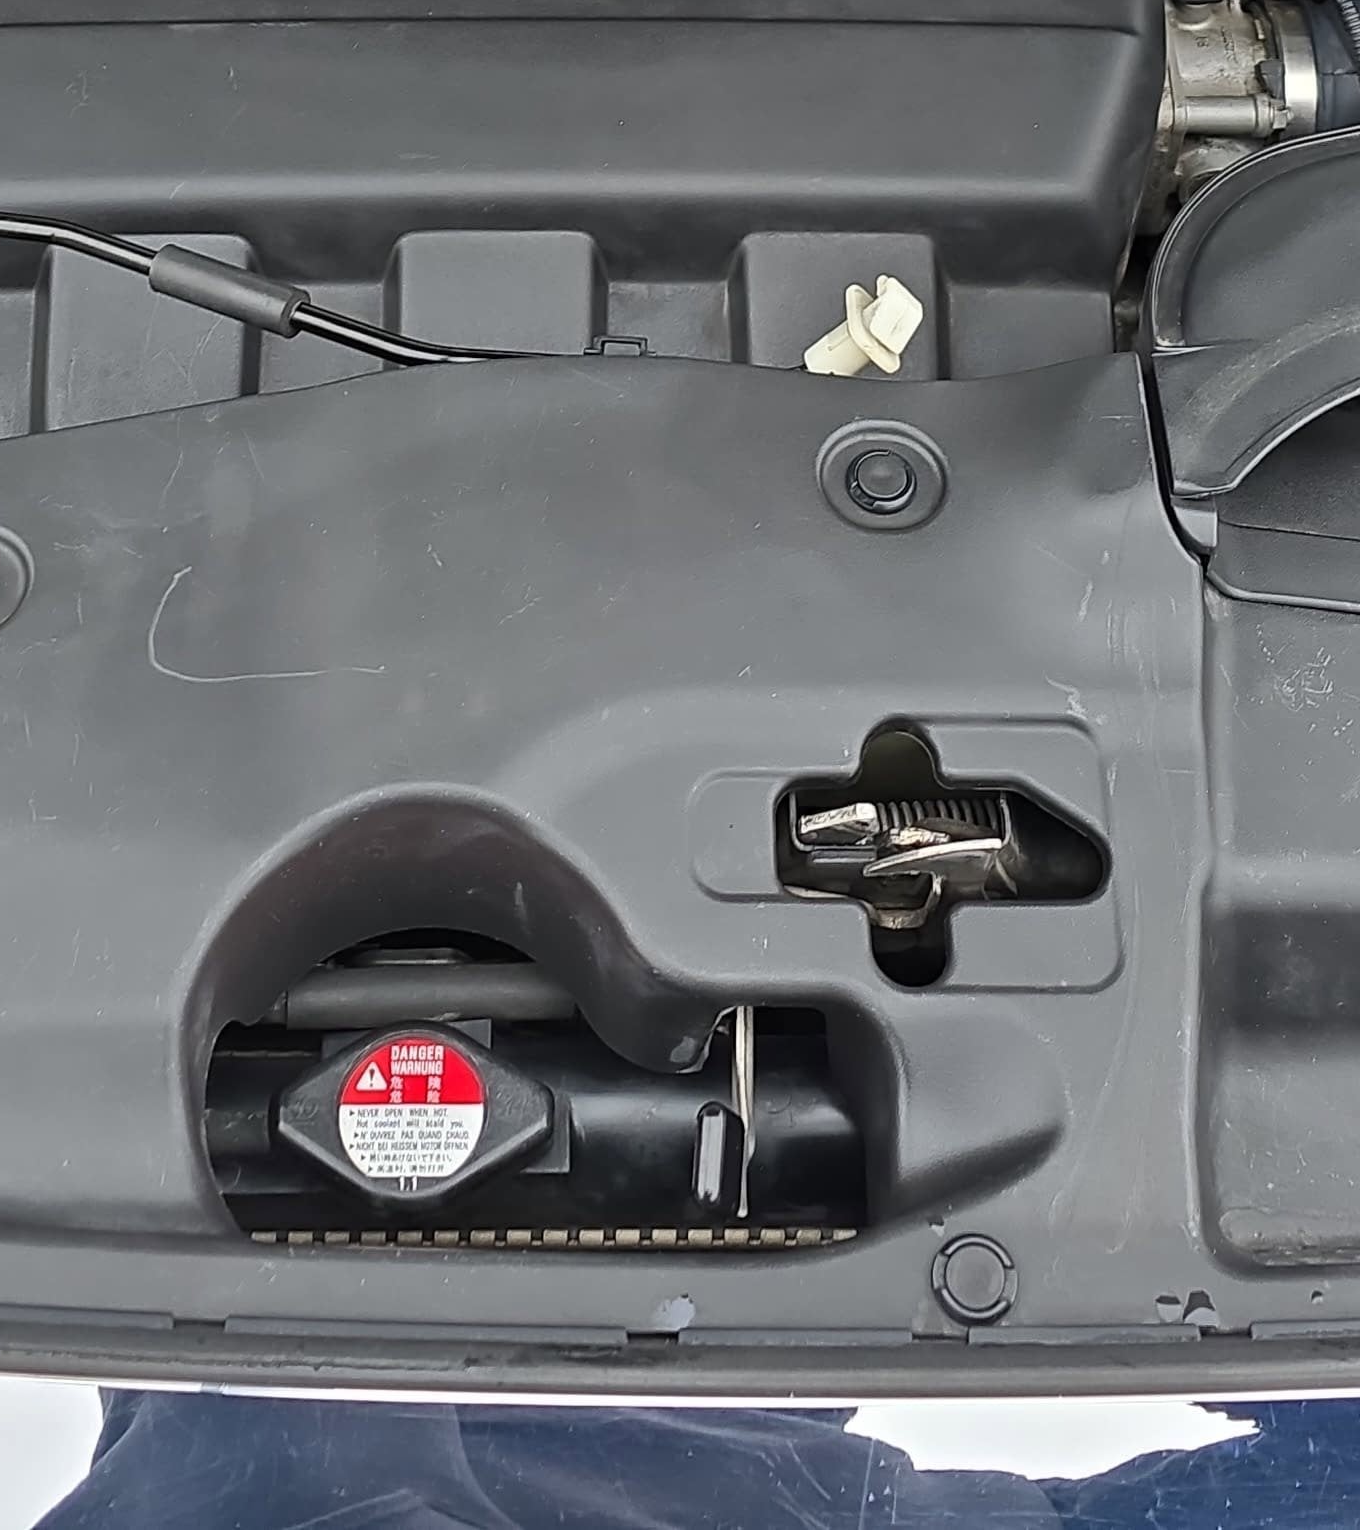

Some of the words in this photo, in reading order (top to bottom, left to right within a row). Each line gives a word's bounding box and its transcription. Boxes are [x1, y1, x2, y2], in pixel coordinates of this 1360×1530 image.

[391, 1045, 444, 1060] DANGER
[391, 1060, 443, 1075] WARNUNG
[357, 1109, 378, 1117] NEVER
[385, 1109, 403, 1117] OPEN
[409, 1109, 428, 1117] WHEN
[374, 1119, 400, 1128] coolant
[406, 1119, 420, 1127] will
[426, 1119, 444, 1127] scald
[401, 1131, 414, 1139] PAS
[418, 1131, 442, 1140] QUAND
[356, 1142, 374, 1151] NICHT
[421, 1142, 441, 1151] MOTOR
